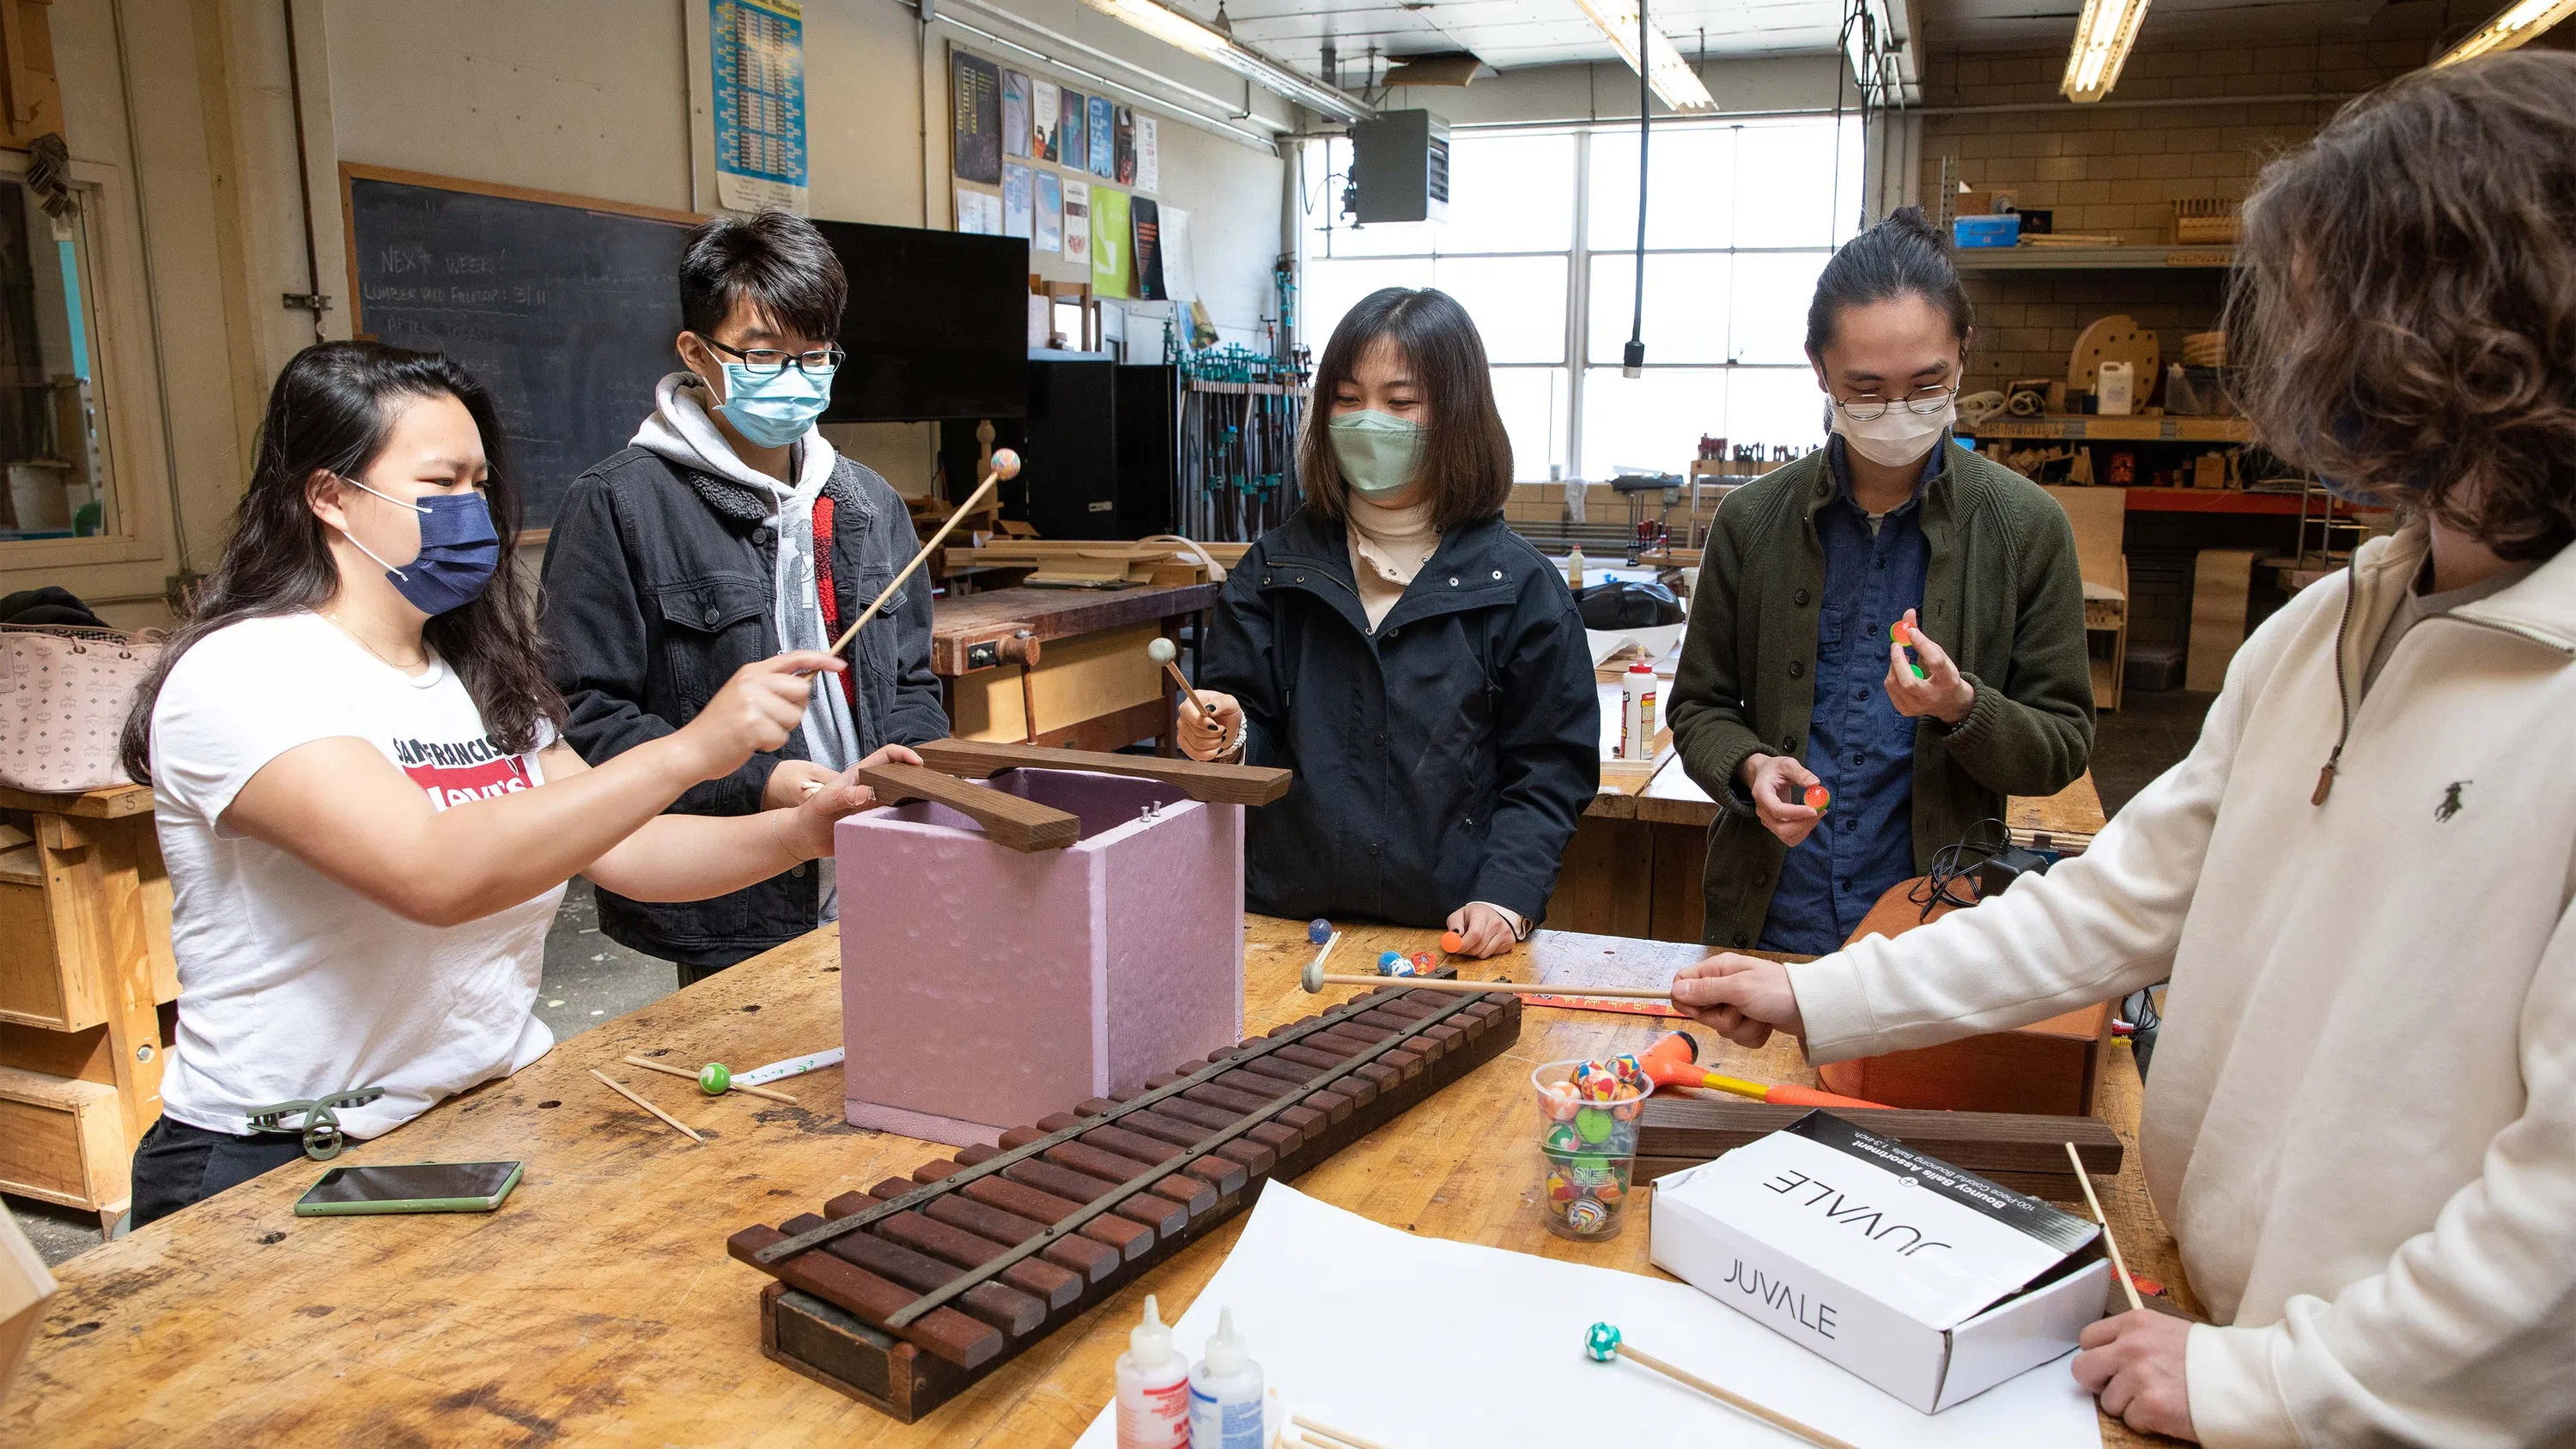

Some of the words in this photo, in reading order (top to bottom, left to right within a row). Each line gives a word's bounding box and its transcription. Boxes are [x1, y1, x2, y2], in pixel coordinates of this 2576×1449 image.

[381, 246, 432, 275] NEXT
[363, 282, 416, 301] LUMBER
[423, 735, 513, 767] FRANCIS
[125, 794, 136, 811] 5
[1851, 1140, 1924, 1173] Assortment
[1913, 1155, 1956, 1177] Bouncing
[1922, 1169, 1956, 1187] Balls
[1953, 1173, 1990, 1191] Colorful
[1953, 1183, 2007, 1210] Bouncy
[1990, 1189, 2036, 1211] 100-Piece
[1762, 1169, 1953, 1257] JUVALE
[1723, 1258, 1838, 1340] JUVALE
